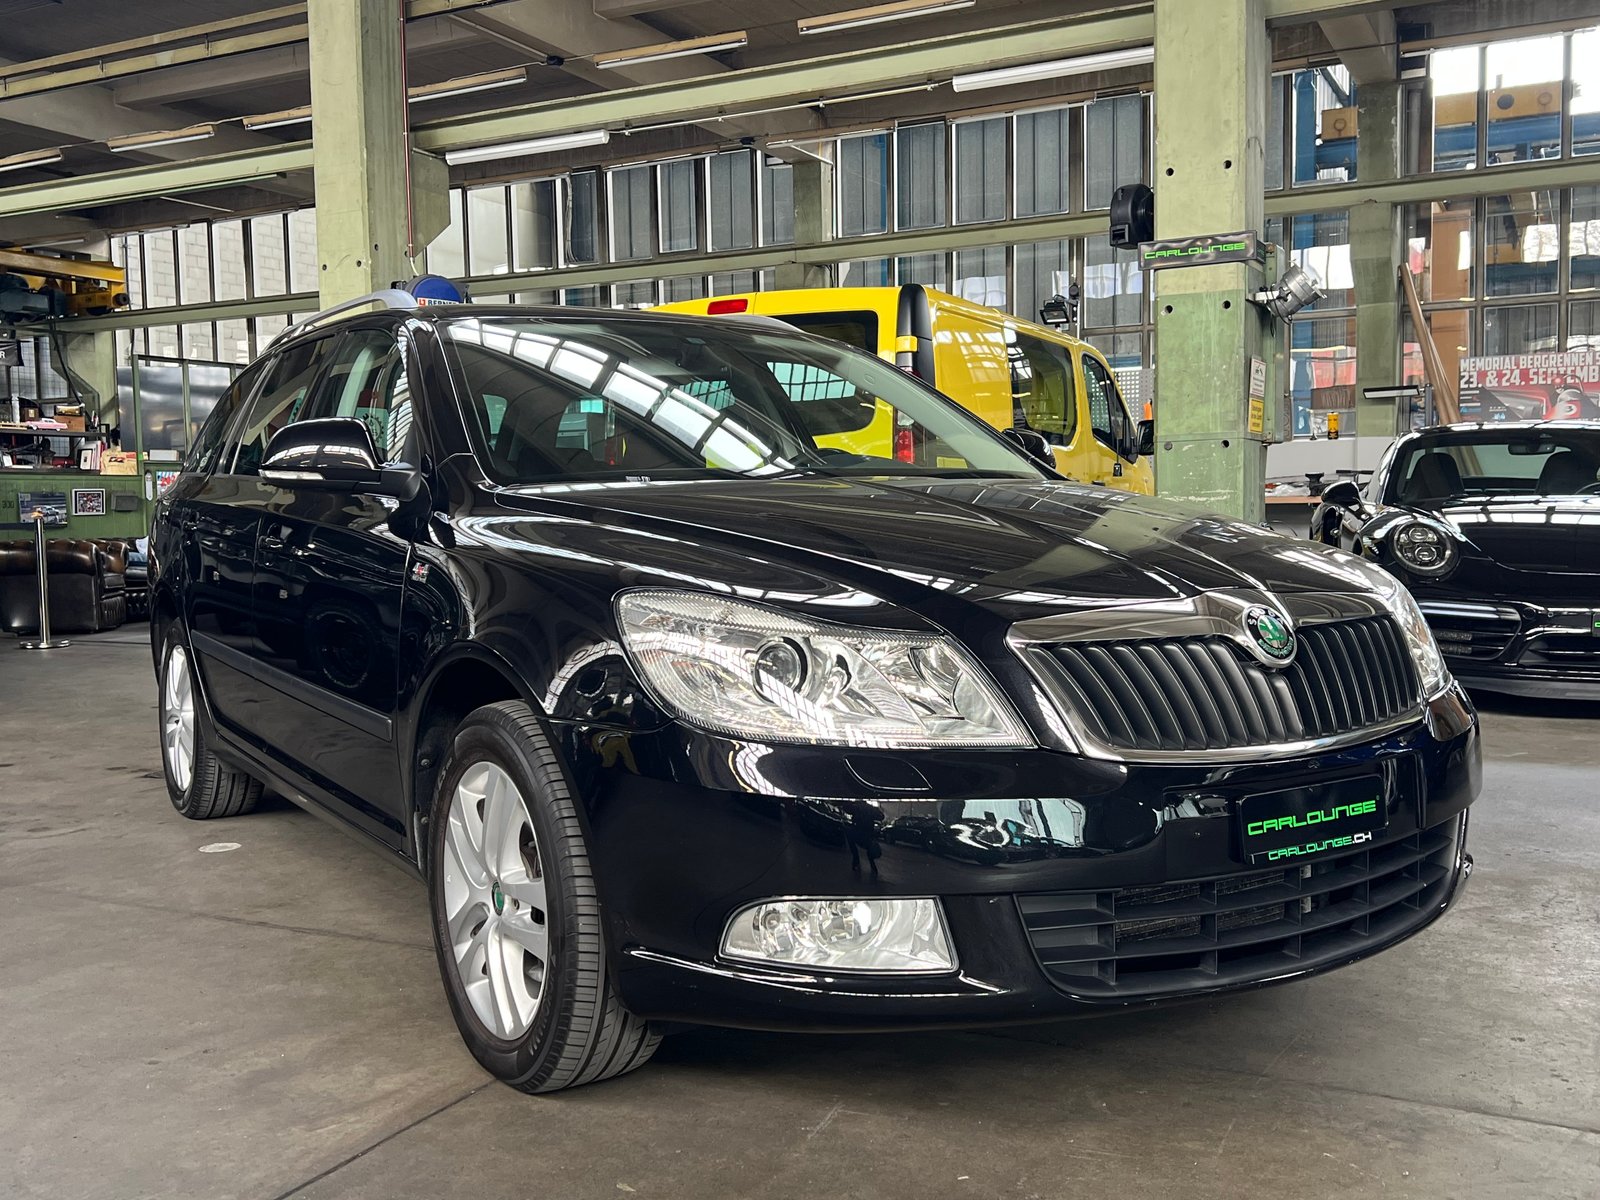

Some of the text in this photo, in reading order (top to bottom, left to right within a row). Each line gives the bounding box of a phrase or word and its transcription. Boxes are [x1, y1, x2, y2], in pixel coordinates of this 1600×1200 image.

[1144, 242, 1246, 259] CARLOUNGE
[1460, 357, 1517, 372] MEMORIAL
[1520, 352, 1592, 369] BERGRENNEN
[1460, 372, 1482, 388] 23.
[1486, 370, 1499, 387] &
[1502, 370, 1525, 386] 24.
[1247, 800, 1377, 836] CARLOUNGE
[1268, 831, 1372, 861] CARLOUNGE.CH
